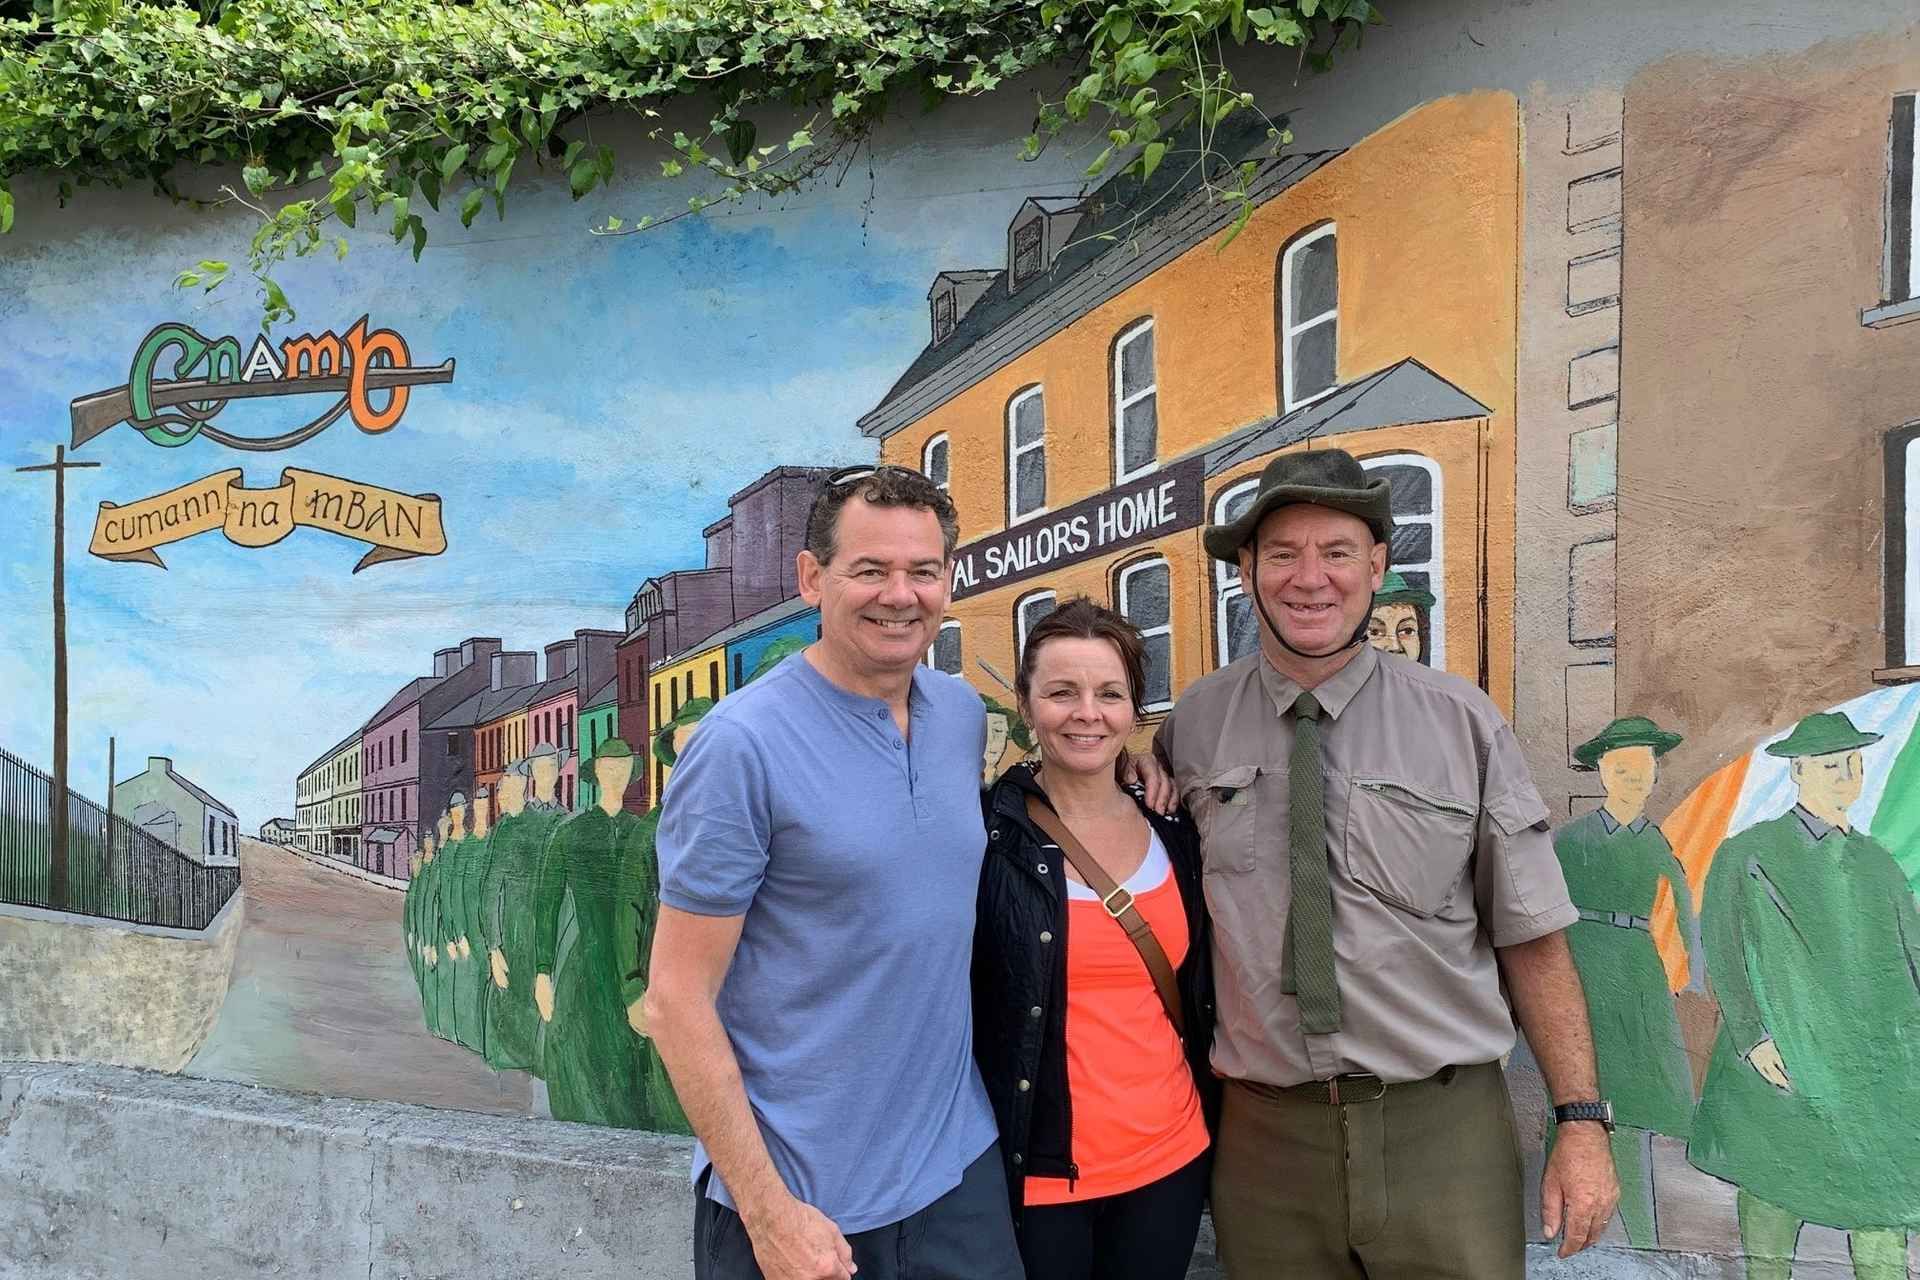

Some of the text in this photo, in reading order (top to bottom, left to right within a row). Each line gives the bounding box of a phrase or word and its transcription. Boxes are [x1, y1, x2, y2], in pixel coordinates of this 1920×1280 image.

[104, 489, 221, 543] cumann
[238, 498, 280, 528] na
[951, 479, 1177, 593] AL SAILORS HOME
